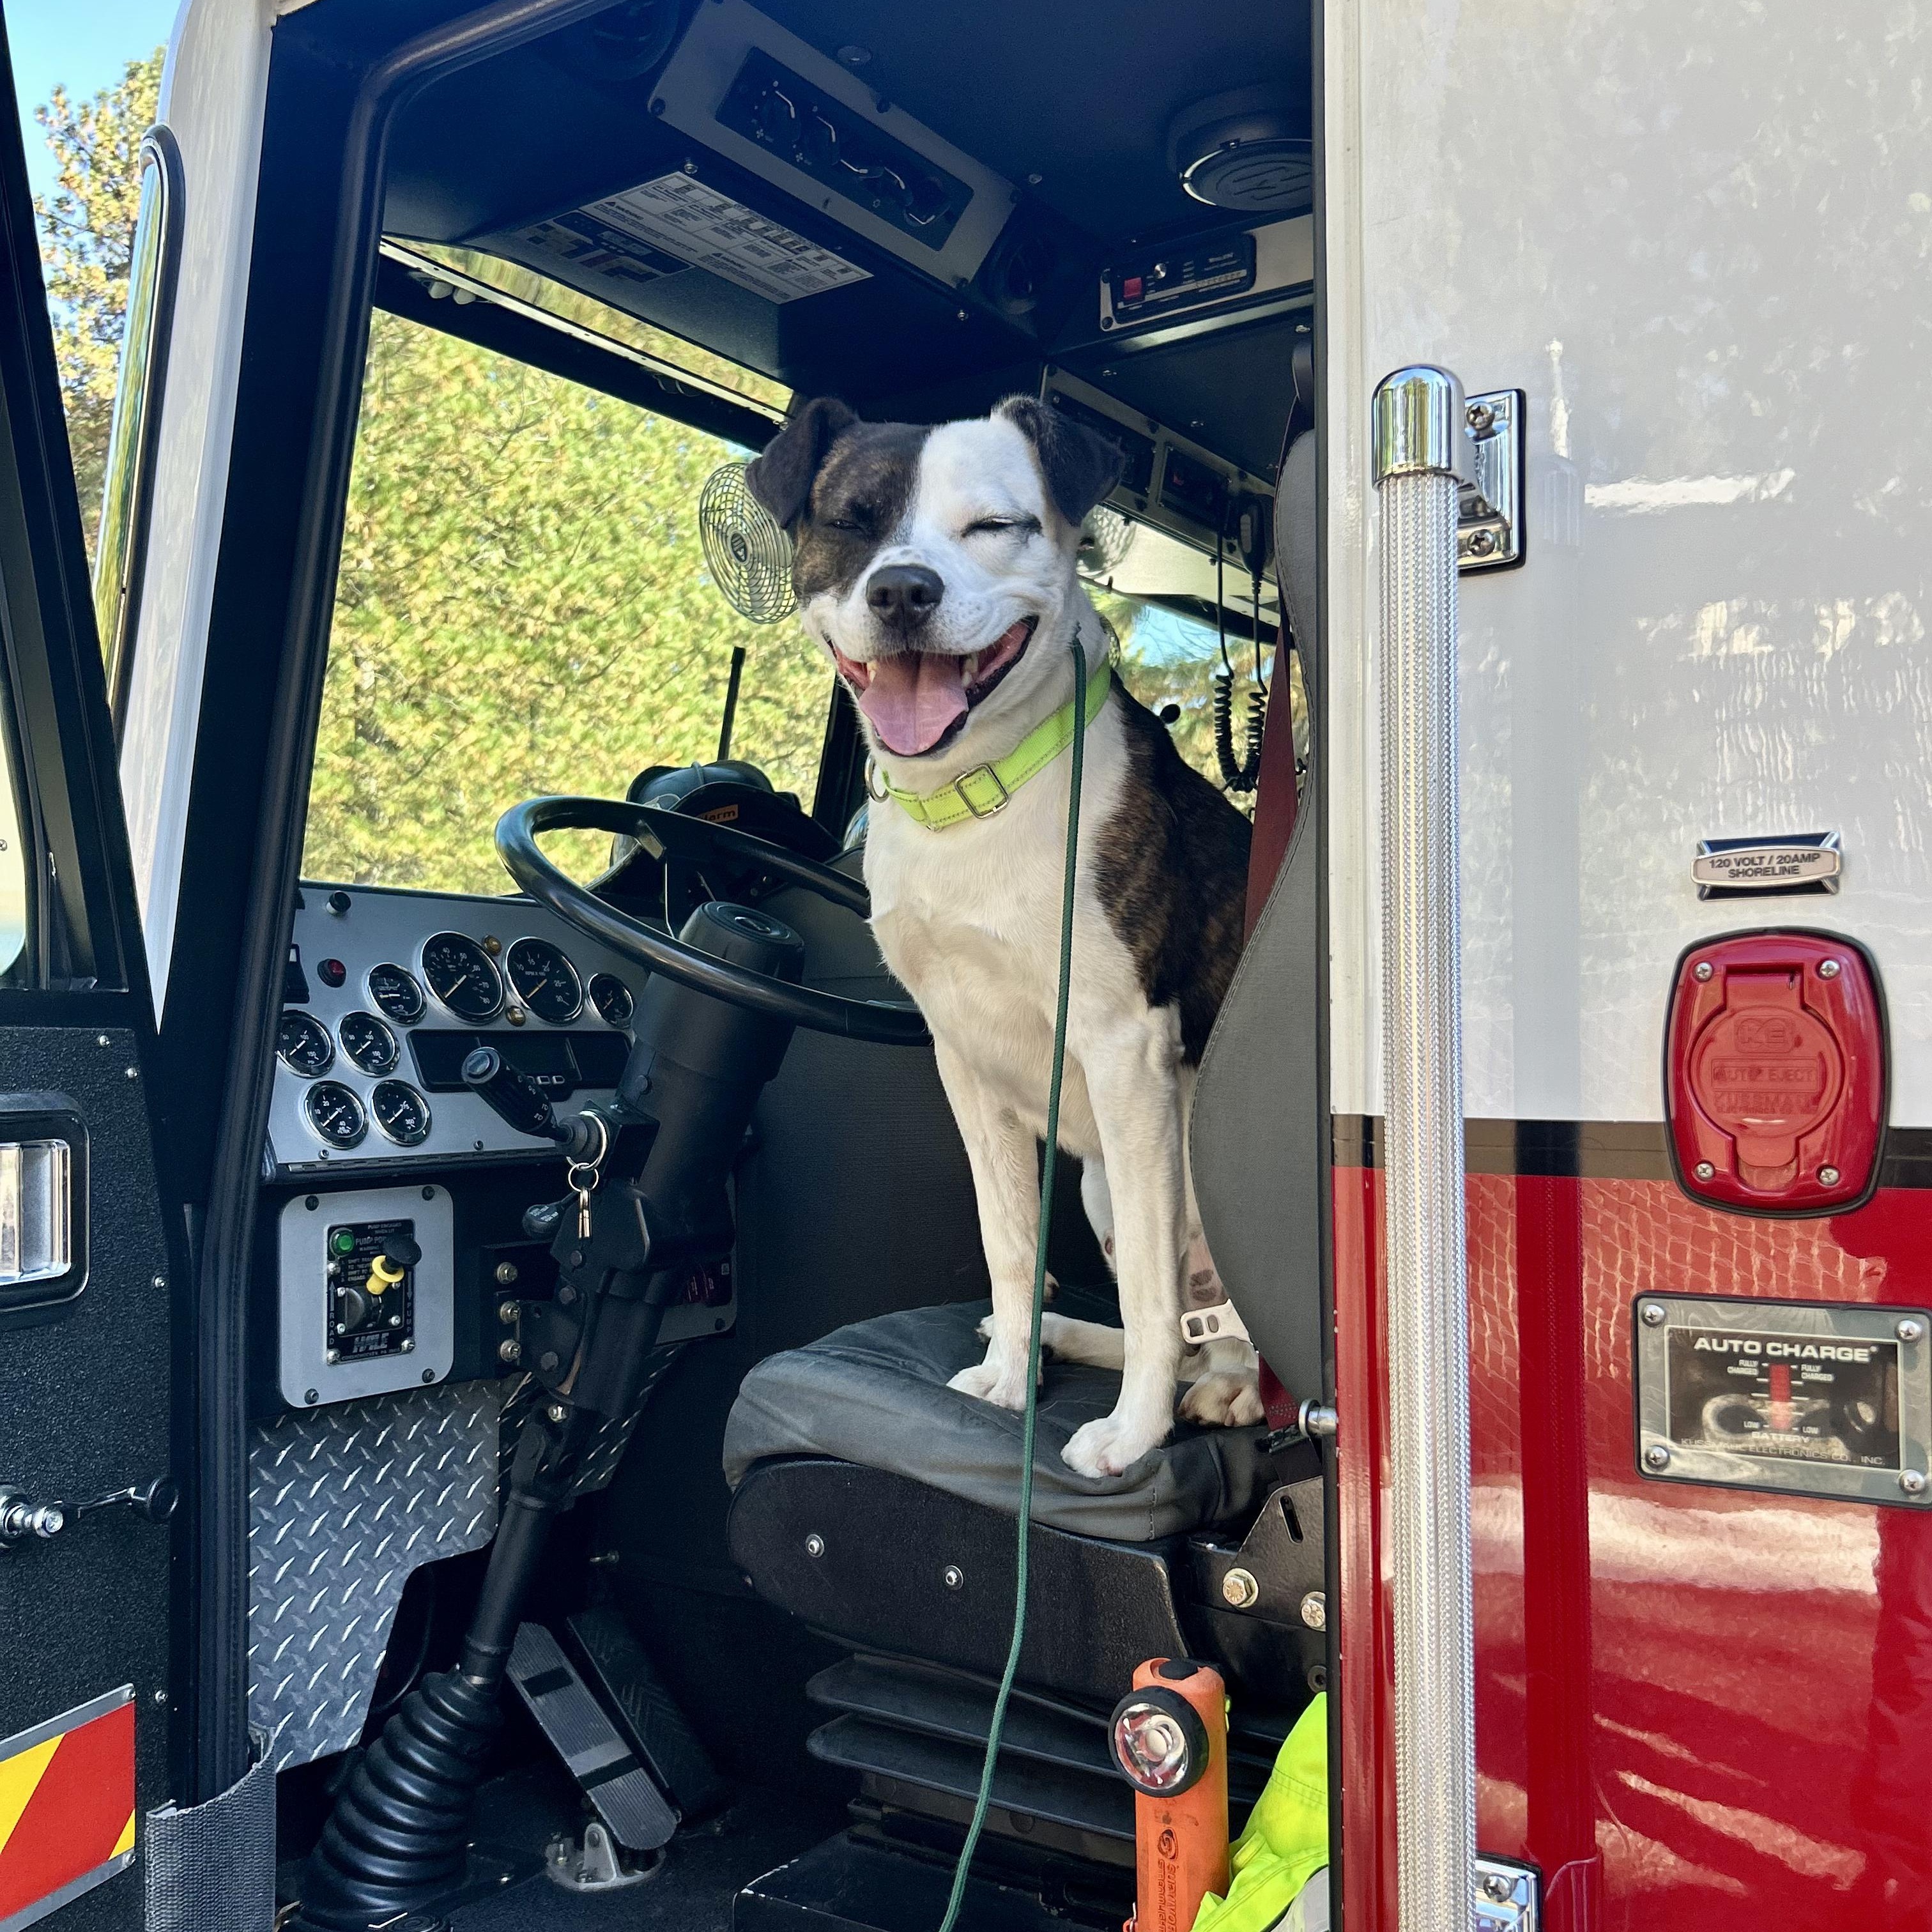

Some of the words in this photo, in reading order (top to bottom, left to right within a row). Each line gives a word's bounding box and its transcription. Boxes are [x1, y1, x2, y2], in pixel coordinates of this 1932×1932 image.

[1709, 859, 1730, 868] 120
[1734, 856, 1765, 867] VOLT
[1767, 855, 1773, 865] /
[1776, 853, 1820, 864] 20AMP
[1728, 865, 1800, 878] SHORELINE
[1768, 1068, 1814, 1081] EJECT
[1694, 1337, 1761, 1354] AUTO
[1738, 1359, 1758, 1367] FULLY
[1801, 1364, 1821, 1372] FULLY
[1727, 1366, 1759, 1376] CHARGED
[1801, 1372, 1834, 1382] CHARGED
[1751, 1431, 1810, 1443] BATTERY
[1749, 1445, 1828, 1460] ELECTRONICS
[1860, 1455, 1885, 1466] INC.
